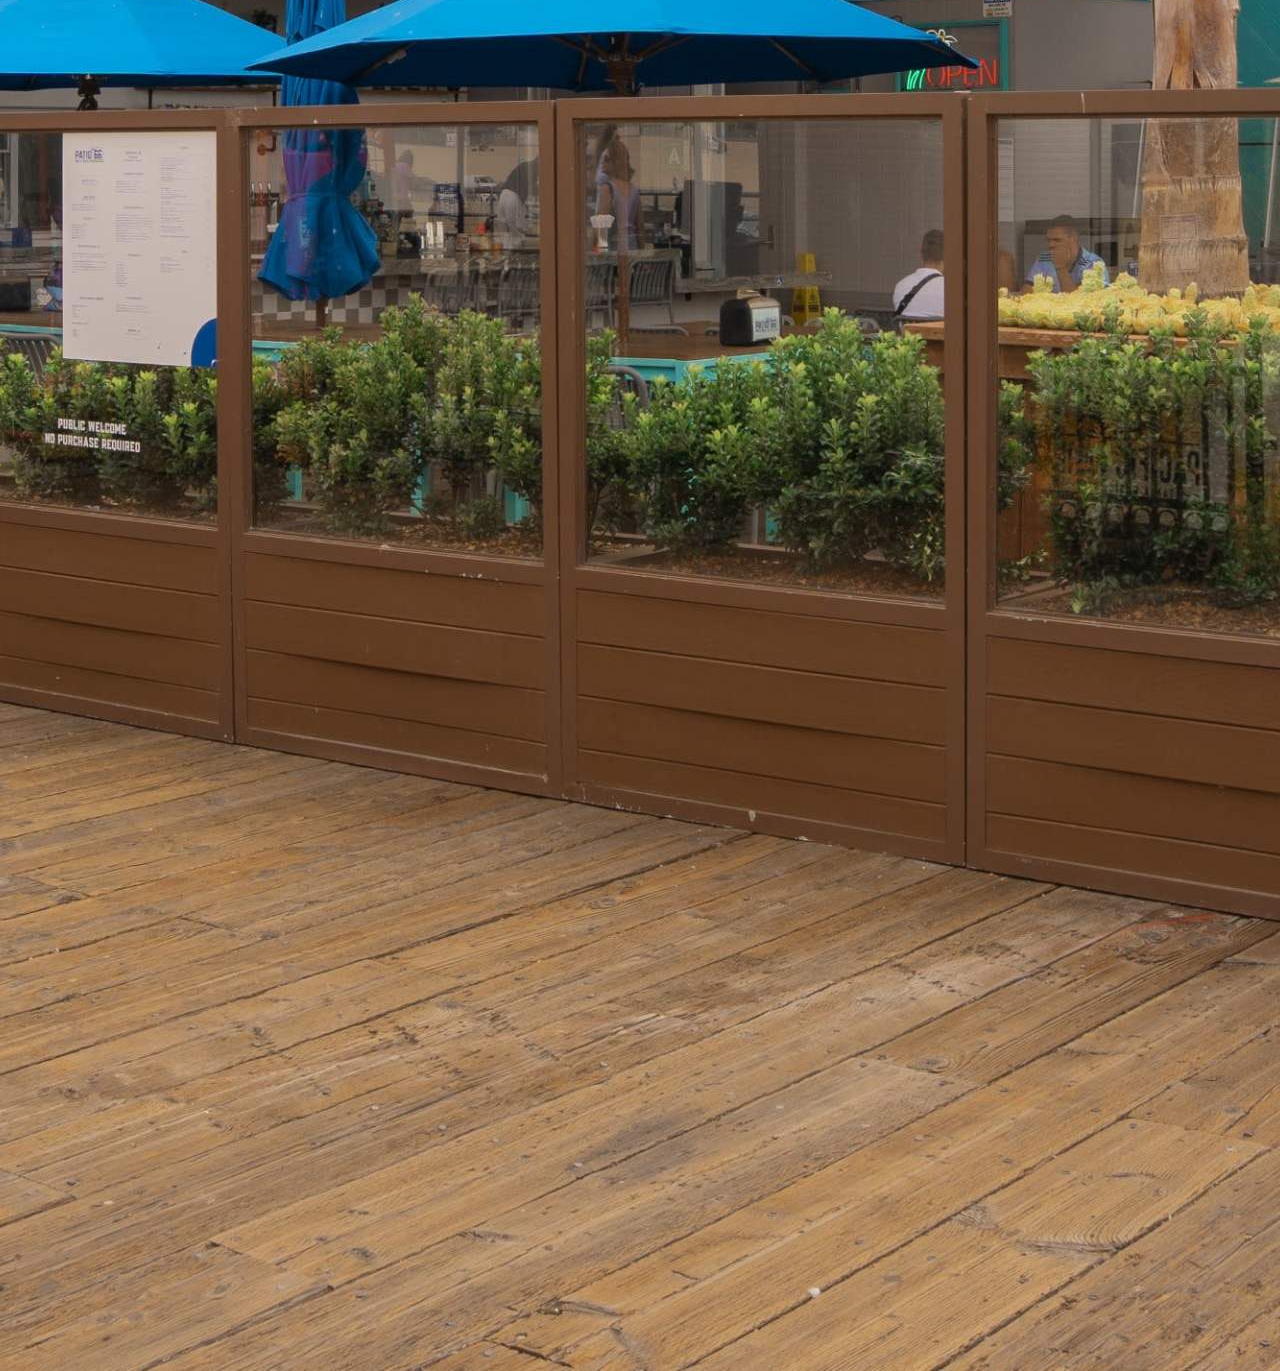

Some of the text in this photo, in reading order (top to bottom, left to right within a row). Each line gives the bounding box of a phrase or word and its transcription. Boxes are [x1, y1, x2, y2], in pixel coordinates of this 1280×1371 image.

[926, 58, 997, 87] OPEN
[58, 418, 127, 435] PUBLIC WELCOME
[45, 432, 141, 453] NO PURCHASE REQUIRED
